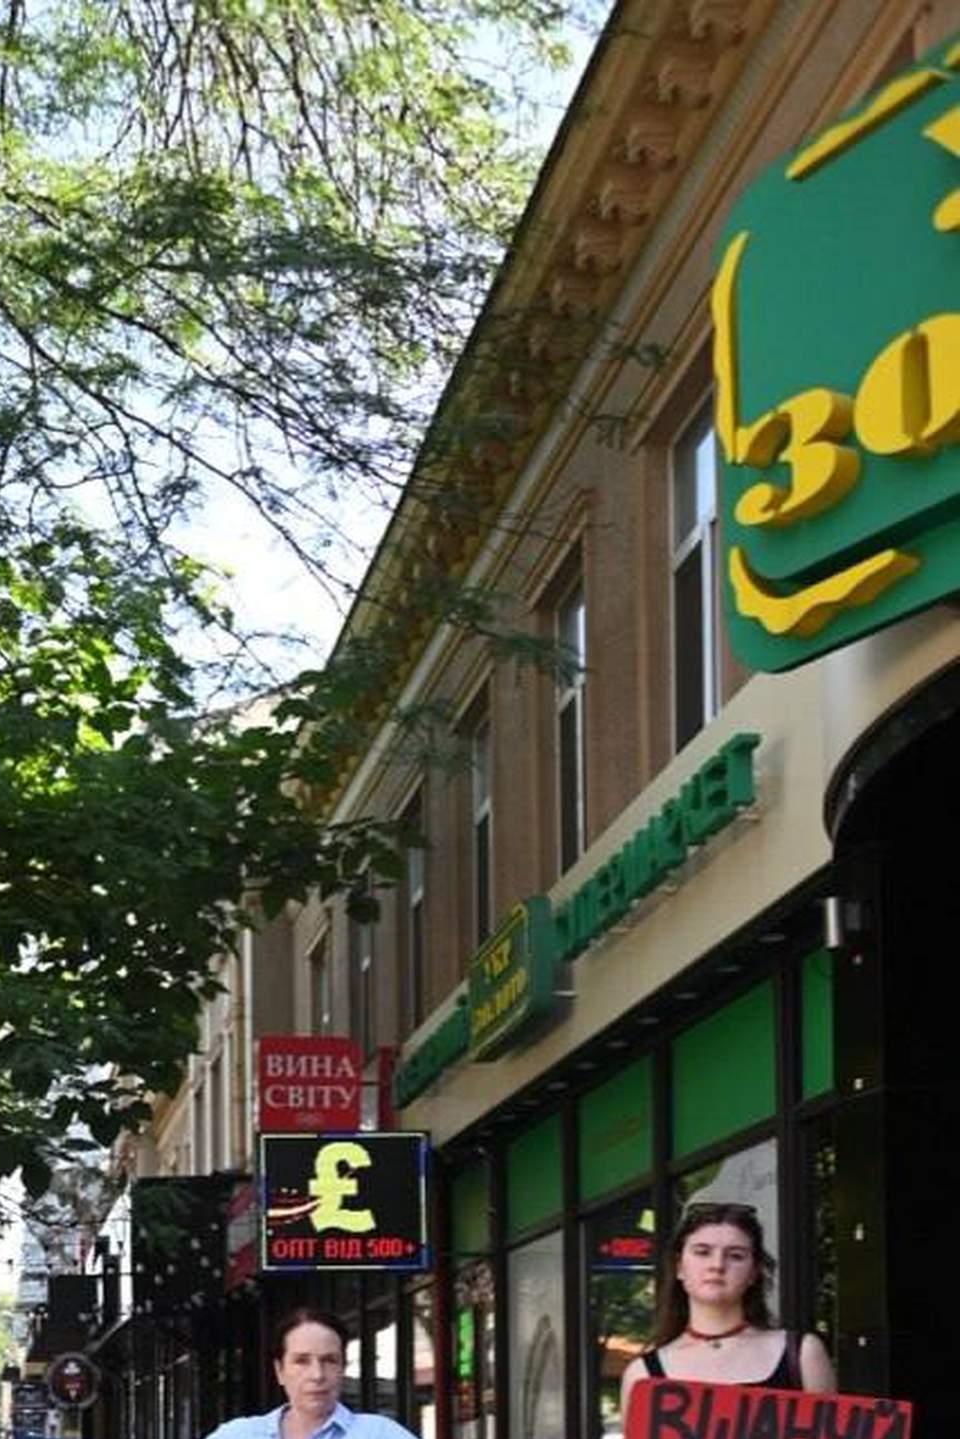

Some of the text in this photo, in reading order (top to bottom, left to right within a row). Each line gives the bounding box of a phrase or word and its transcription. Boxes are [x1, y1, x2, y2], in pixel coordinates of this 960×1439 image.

[266, 1055, 356, 1078] ВИНА
[265, 1085, 356, 1109] СВІТУ
[272, 1239, 317, 1259] ОПТ
[324, 1239, 362, 1258] ВІД
